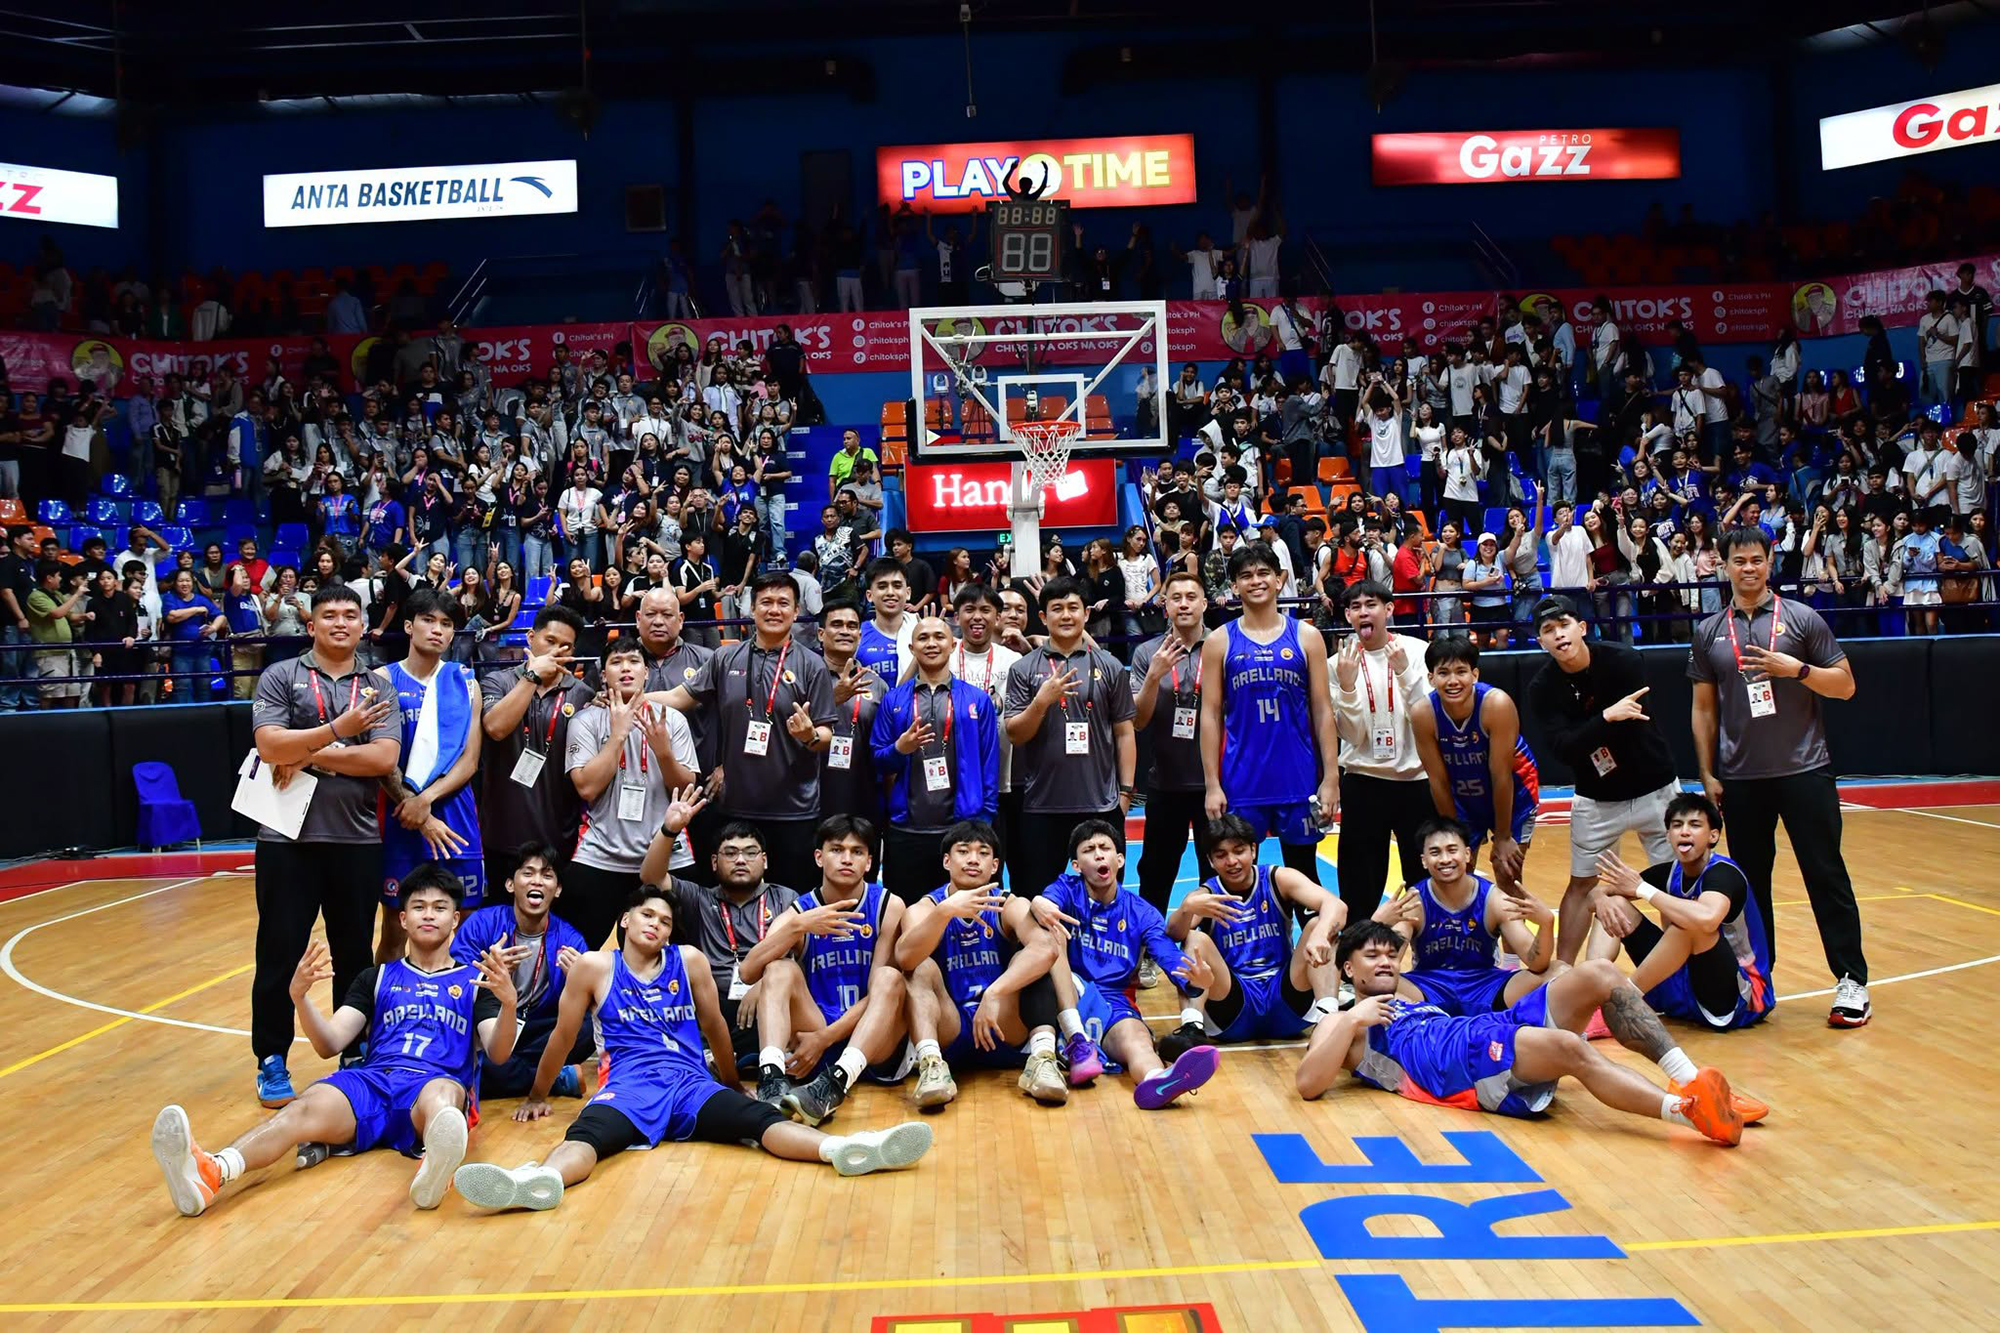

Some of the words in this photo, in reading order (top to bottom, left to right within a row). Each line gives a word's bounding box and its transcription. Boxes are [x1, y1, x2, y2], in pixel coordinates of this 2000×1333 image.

[1892, 103, 2000, 149] Ga
[1539, 134, 1592, 145] PETRO
[1459, 134, 1592, 179] Gazz
[902, 156, 1019, 200] PLAY
[1063, 150, 1170, 189] TIME
[291, 184, 349, 210] ANTA
[357, 177, 504, 208] BASKETBALL
[1573, 296, 1692, 322] CITOK'S
[1166, 311, 1188, 319] itok's
[869, 320, 902, 329] Chitok's
[1167, 326, 1195, 335] toksph
[707, 325, 831, 352] CHITK'S
[869, 336, 909, 345] chitoksph
[1057, 341, 1078, 350] OKS
[1081, 341, 1095, 350] NA
[1098, 340, 1119, 349] OKS
[1167, 343, 1196, 352] toksph
[811, 351, 832, 360] OKS
[869, 353, 910, 362] chitoksph
[510, 363, 531, 373] OKS
[932, 474, 1045, 508] Han
[999, 533, 1012, 543] EX
[1232, 667, 1304, 691] ARELLANO
[1762, 690, 1771, 701] B
[1257, 698, 1280, 723] 14
[1187, 717, 1194, 727] B
[759, 731, 767, 742] B
[1079, 731, 1087, 741] B
[1385, 736, 1393, 746] B
[843, 746, 850, 755] B
[1600, 748, 1609, 759] B
[938, 766, 946, 776] B
[1456, 779, 1485, 797] 25
[811, 949, 873, 974] RELLAN
[946, 950, 1000, 972] RELLAN
[836, 984, 859, 1012] 10
[618, 1005, 696, 1024] ARELANO
[401, 1032, 433, 1058] 17
